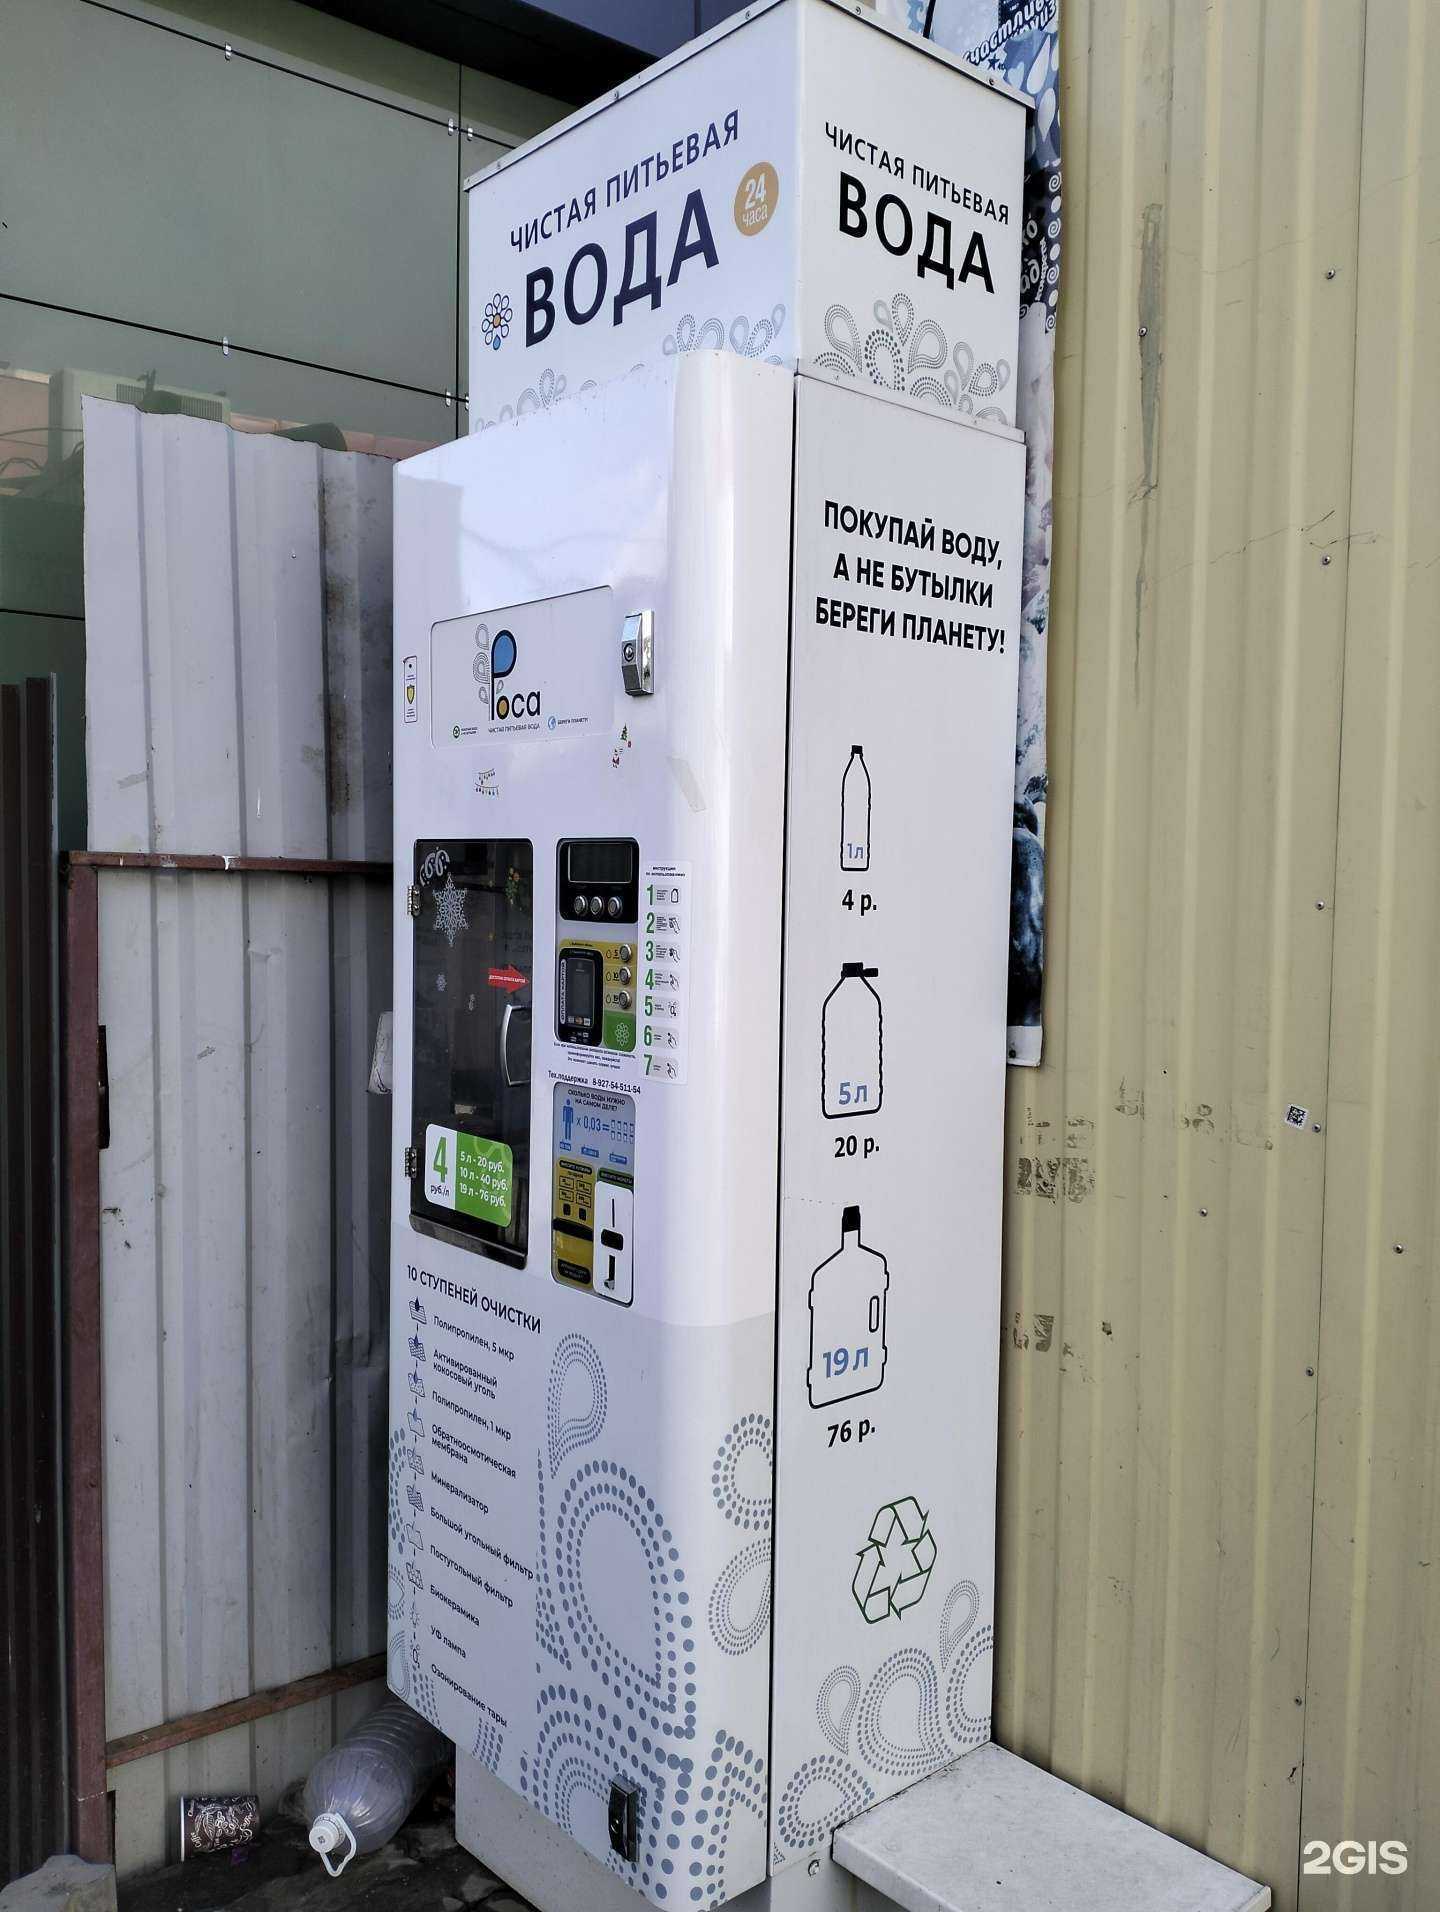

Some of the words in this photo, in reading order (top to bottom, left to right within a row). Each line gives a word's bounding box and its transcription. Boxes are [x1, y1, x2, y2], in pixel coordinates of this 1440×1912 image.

[510, 190, 596, 254] ЧИСТАЯ
[606, 109, 739, 208] ПИТЬЕВАЯ
[745, 173, 766, 210] 24
[824, 121, 904, 179] ЧИСТАЯ
[912, 166, 1009, 225] ПИТЬЕВАЯ
[743, 204, 767, 228] часа
[838, 172, 995, 294] ВОДА
[526, 188, 719, 348] ВОДА
[825, 500, 935, 551] ПОКУПАЙ
[942, 528, 1002, 570] ВОДУ,
[833, 553, 850, 581] А
[857, 557, 885, 588] НЕ
[891, 564, 993, 608] БУТЫЛКИ
[816, 596, 896, 637] БЕРЕГИ
[902, 612, 1005, 654] ПЛАНЕТУ!
[491, 629, 541, 721] Роса
[647, 884, 654, 906] 1
[841, 889, 855, 911] 4
[860, 896, 878, 916] р.
[646, 912, 655, 933] 2
[645, 940, 654, 961] 3
[644, 968, 655, 990] 4
[644, 995, 653, 1017] 5
[643, 1025, 652, 1046] 6
[643, 1054, 652, 1076] 7
[433, 1136, 448, 1183] 4
[460, 1152, 465, 1161] 5
[478, 1156, 487, 1168] 20
[488, 1162, 504, 1173] руб.
[834, 1135, 858, 1159] 20
[864, 1135, 880, 1159] р.
[460, 1167, 468, 1178] 10
[481, 1175, 490, 1184] 40
[492, 1179, 508, 1191] руб.
[460, 1183, 467, 1194] 19
[480, 1191, 488, 1202] 76
[490, 1196, 506, 1207] руб.
[408, 1265, 417, 1281] 10
[420, 1271, 478, 1308] СТУПЕНЕЙ
[481, 1296, 541, 1334] ОЧИСТКИ
[434, 1316, 490, 1351] Полипропилен,
[492, 1342, 497, 1352] 5
[499, 1345, 515, 1361] мкр
[433, 1362, 473, 1388] кокосовый
[474, 1382, 496, 1399] уголь
[434, 1349, 497, 1387] Активированный
[432, 1390, 489, 1430] Полипропилен,
[490, 1420, 494, 1431] 1
[496, 1426, 511, 1441] мкр
[827, 1419, 852, 1448] 76
[858, 1418, 875, 1442] р.
[432, 1437, 468, 1464] мембрана
[432, 1424, 516, 1479] Обратноосмотическая
[431, 1471, 488, 1514] Минерализатор
[430, 1507, 463, 1535] Большой
[465, 1530, 501, 1560] угольный
[503, 1554, 534, 1580] фильтр
[430, 1544, 482, 1588] Постугольный
[484, 1582, 513, 1608] фильтр
[430, 1584, 480, 1626] Биокерамика
[431, 1625, 442, 1640] УФ
[443, 1637, 466, 1659] лампа
[431, 1664, 486, 1711] Озонирование
[487, 1707, 507, 1727] тары
